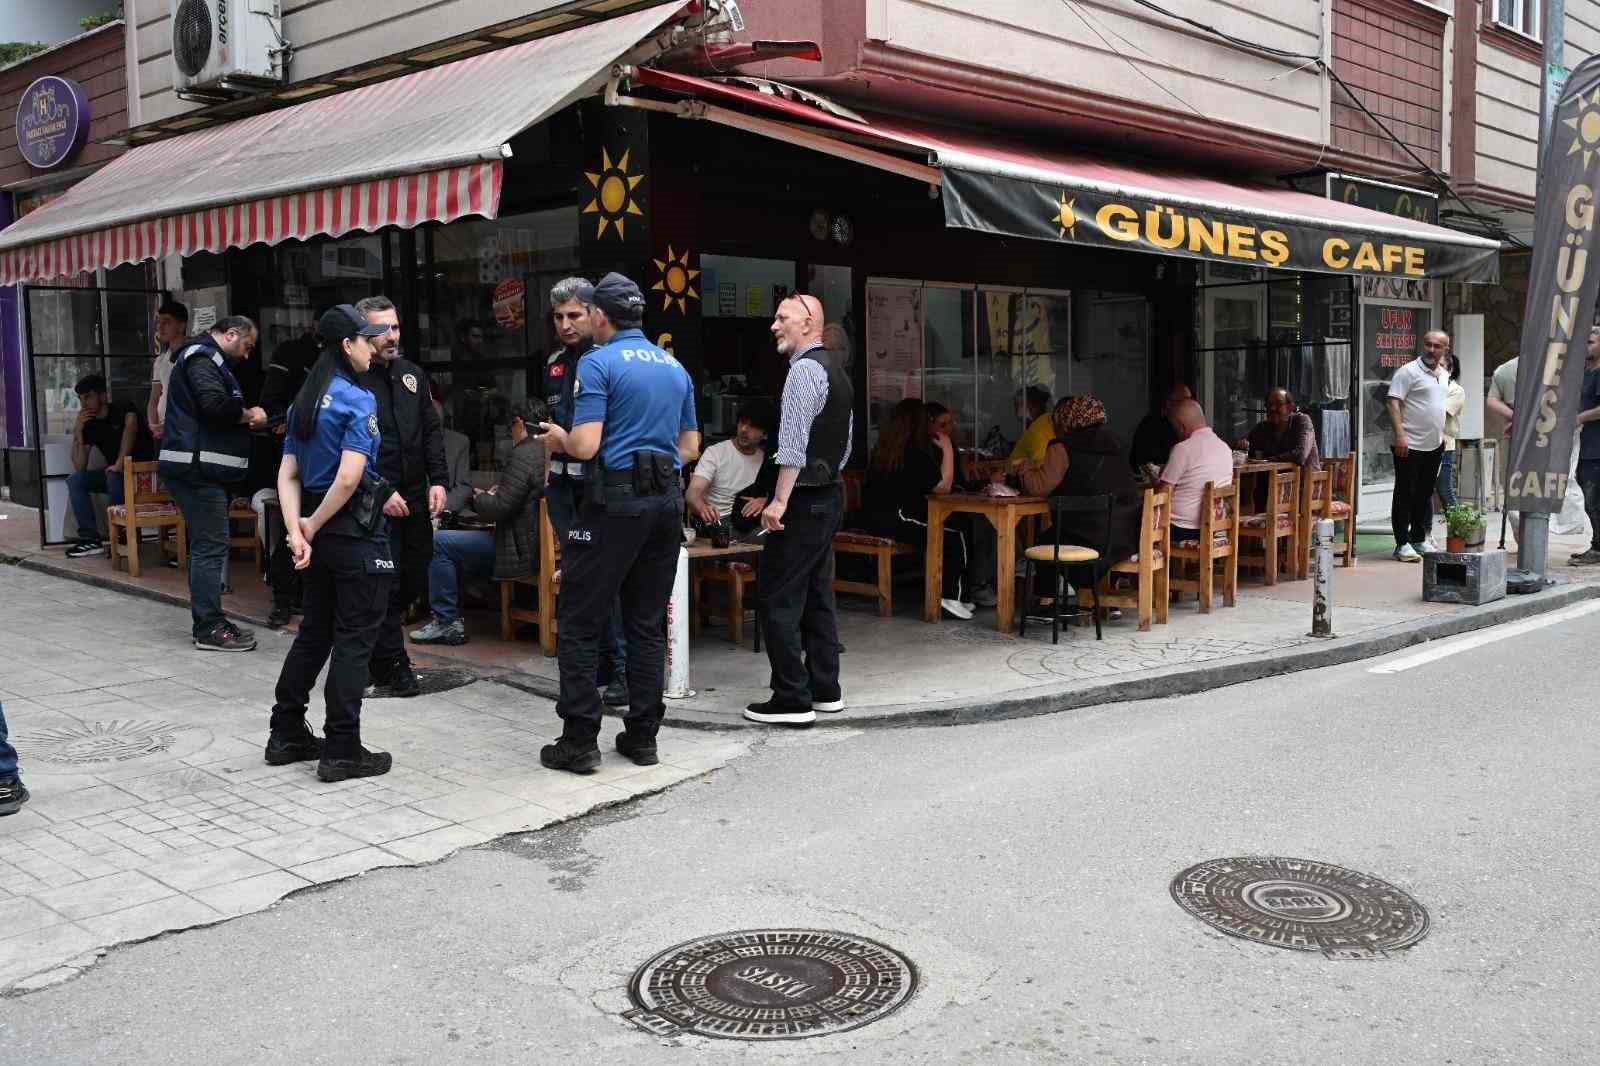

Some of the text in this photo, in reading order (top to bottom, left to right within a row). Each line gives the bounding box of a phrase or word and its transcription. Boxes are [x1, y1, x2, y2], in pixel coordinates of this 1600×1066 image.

[218, 0, 229, 44] arçe
[1096, 203, 1290, 267] GÜNEŞ
[1322, 238, 1425, 275] CAFE
